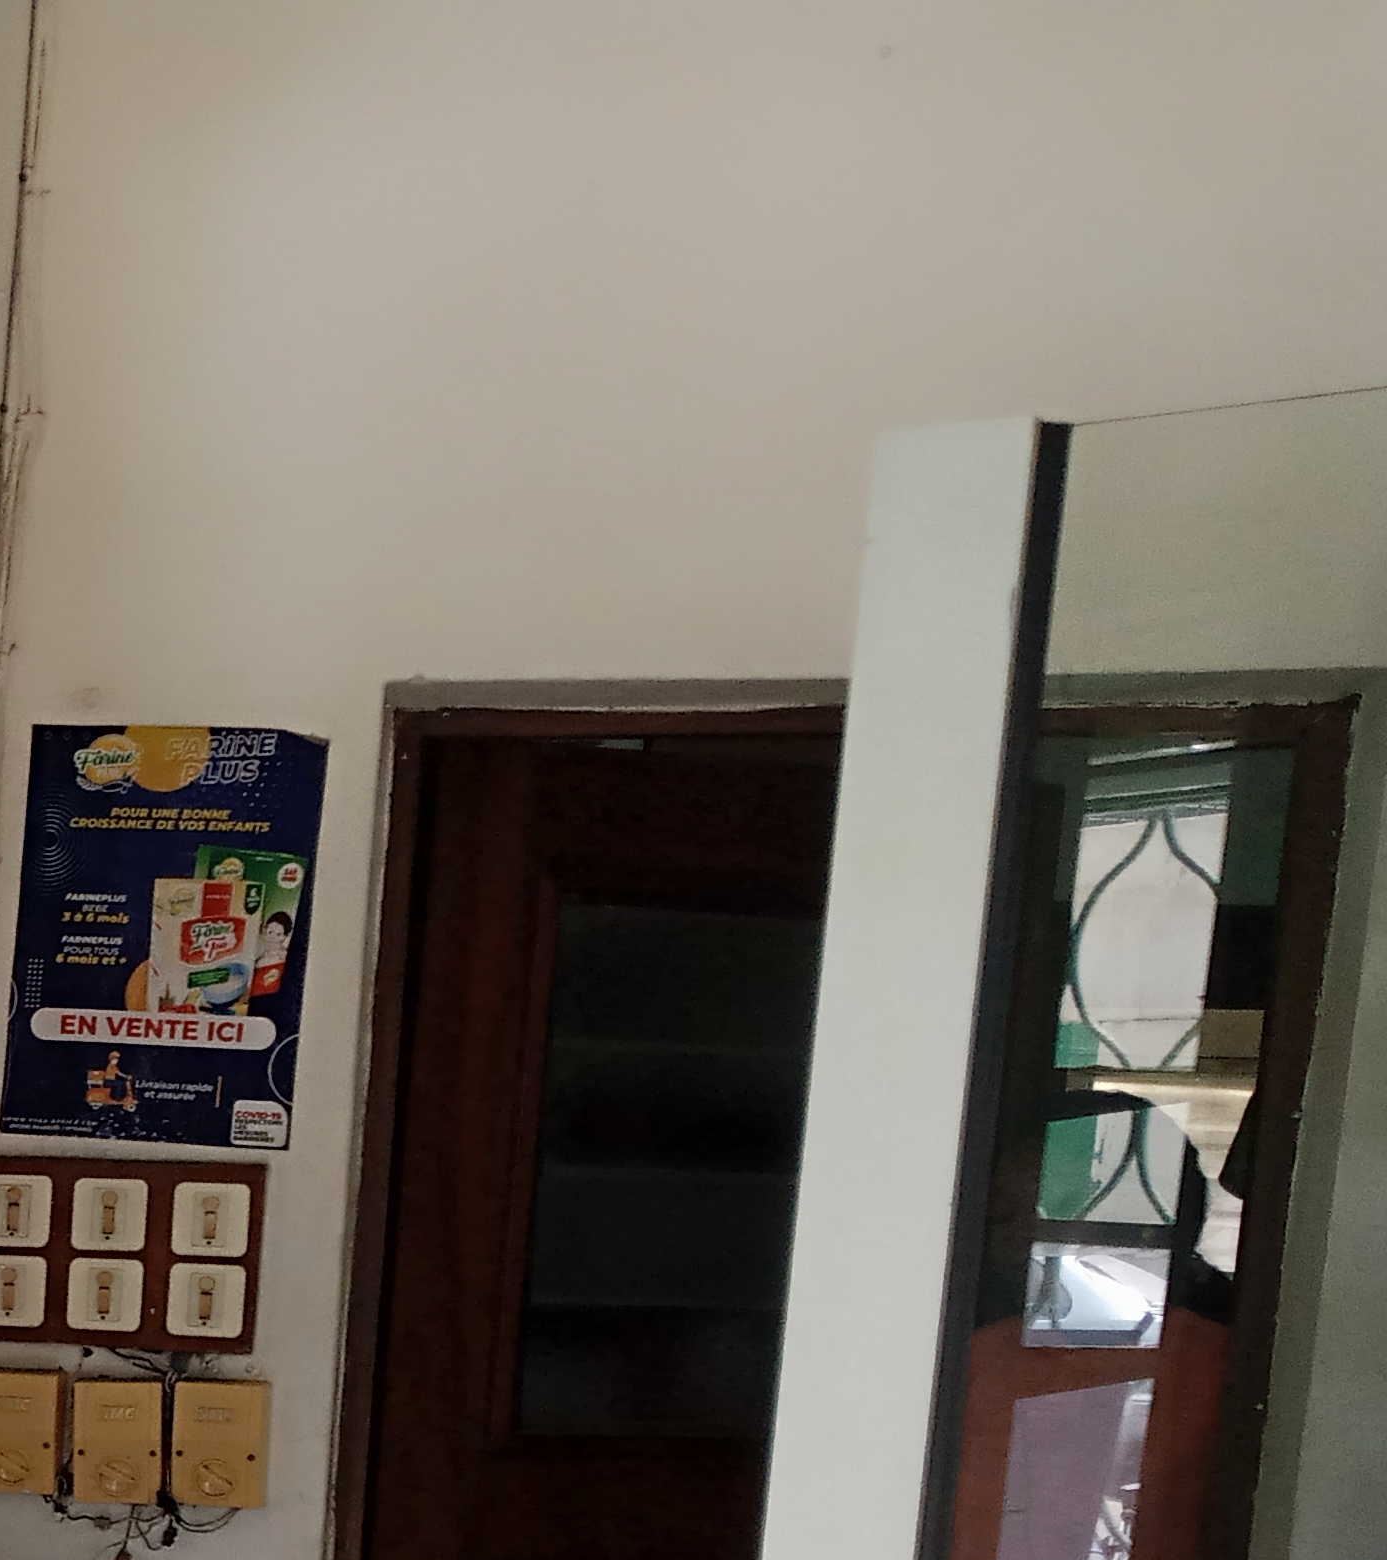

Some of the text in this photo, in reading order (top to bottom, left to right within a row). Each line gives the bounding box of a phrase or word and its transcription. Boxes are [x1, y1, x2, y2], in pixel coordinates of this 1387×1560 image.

[164, 734, 277, 760] FARINE
[182, 760, 260, 785] PLUS
[111, 808, 231, 819] POUR UNE BONNE
[70, 817, 152, 830] CROISSANCE
[156, 819, 175, 830] DE
[208, 821, 270, 834] ENFANTS
[97, 913, 130, 924] mois
[60, 1015, 245, 1042] EN VENTE ICI
